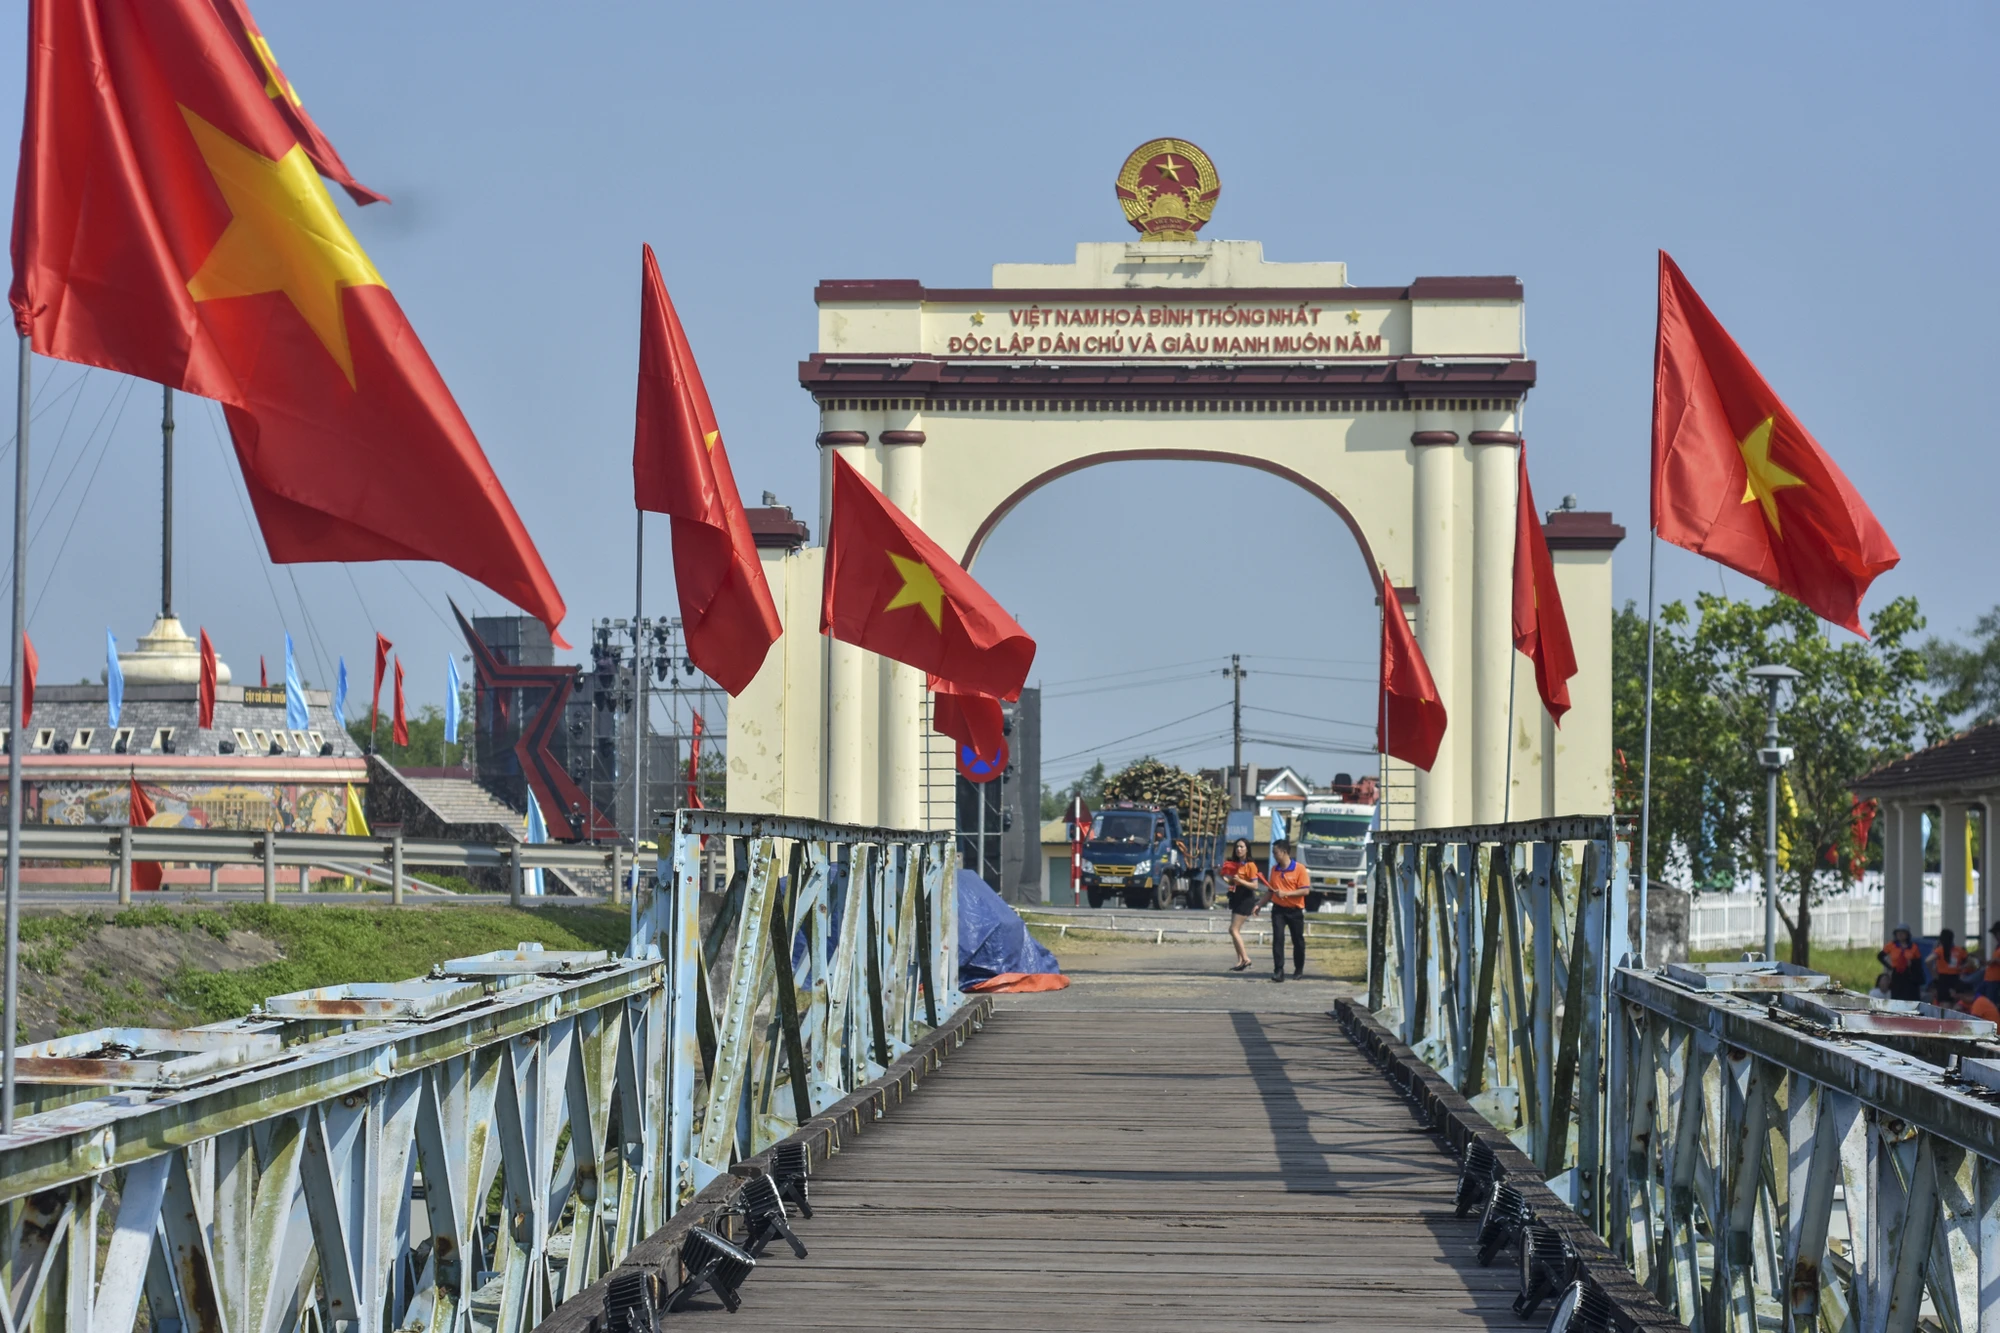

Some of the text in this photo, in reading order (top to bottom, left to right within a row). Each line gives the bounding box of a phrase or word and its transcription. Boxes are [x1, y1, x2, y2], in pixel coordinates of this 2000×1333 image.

[1009, 302, 1323, 331] VIỆT NAM HOÀ BÌNH THỐNG NHẤT
[948, 332, 992, 357] ĐỘC
[995, 331, 1035, 357] LẬP
[1038, 331, 1081, 354] DÂN
[1084, 329, 1124, 354] CHỦ
[1213, 335, 1270, 357] MẠNH
[1273, 332, 1331, 353] MUÔN
[1334, 331, 1382, 353] NĂM
